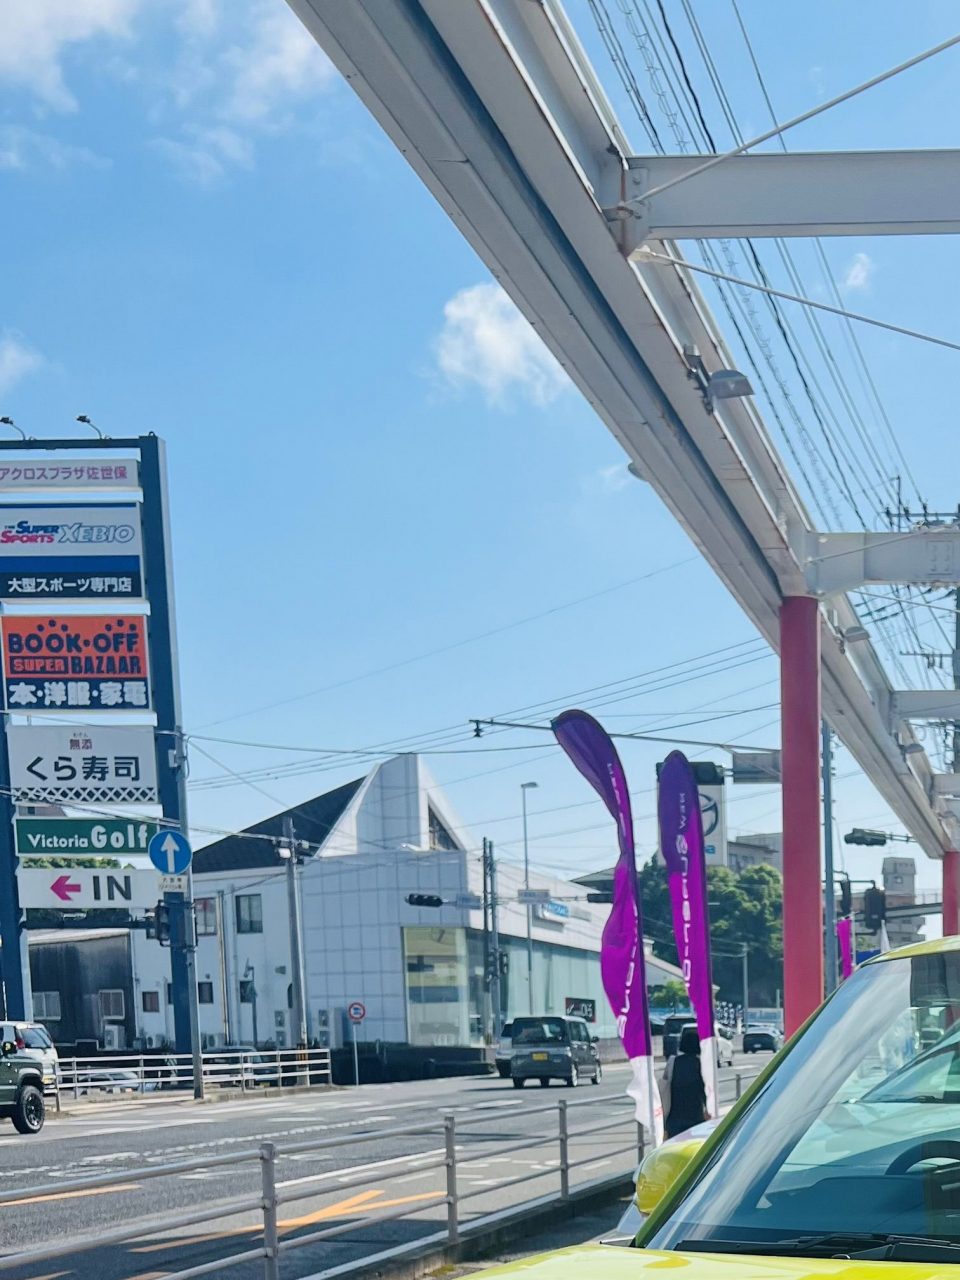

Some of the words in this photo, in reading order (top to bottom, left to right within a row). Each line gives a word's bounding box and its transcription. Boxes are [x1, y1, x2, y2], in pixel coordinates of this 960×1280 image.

[58, 522, 135, 544] XEBIO
[7, 577, 132, 593] 大型スポーツ専門店
[13, 657, 66, 673] SUPER
[71, 656, 141, 674] BAZAAR
[26, 756, 140, 782] くら寿司
[27, 833, 89, 848] Victoria
[91, 824, 148, 848] Golf
[92, 875, 132, 901] IN
